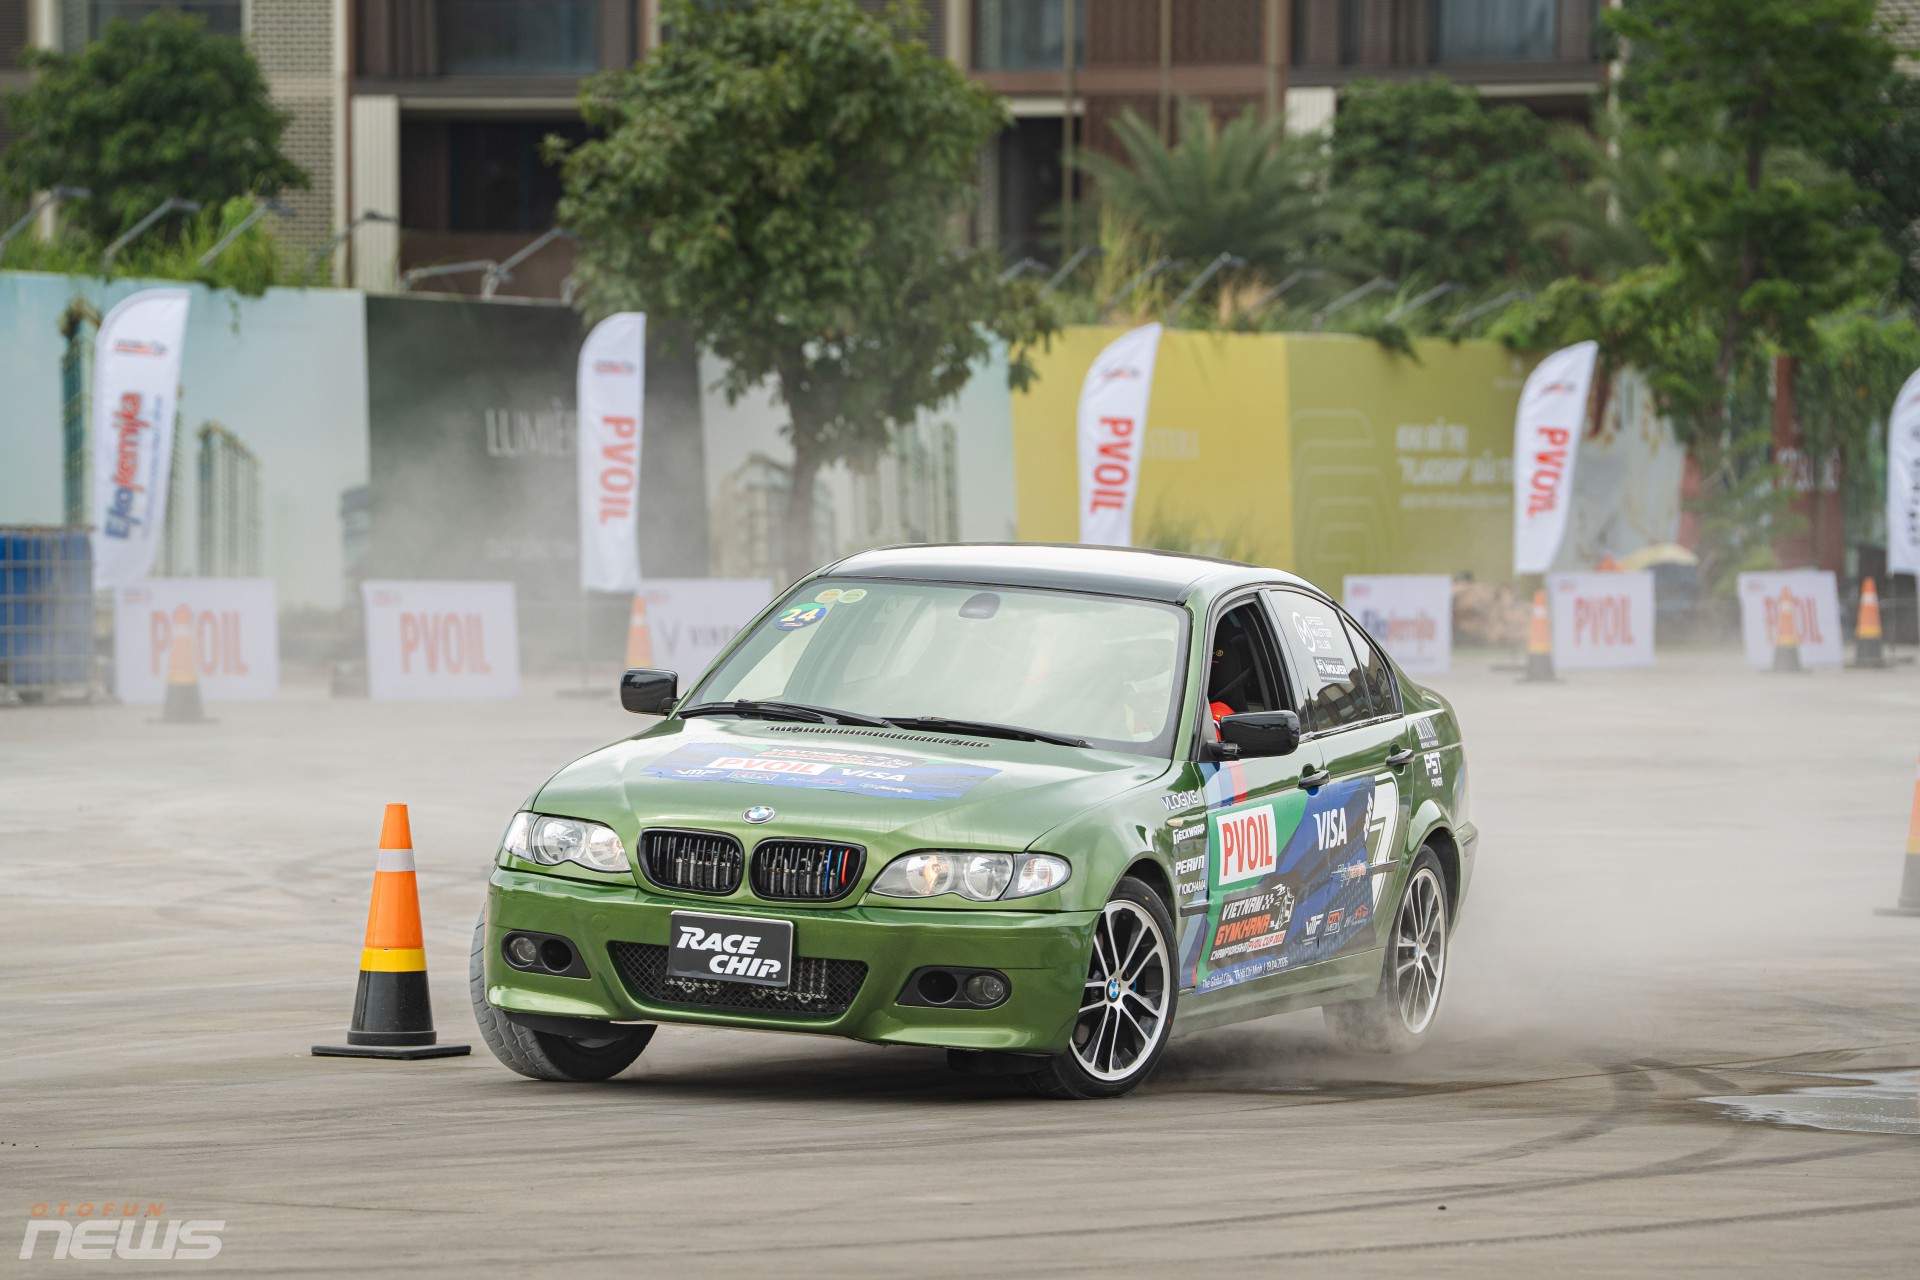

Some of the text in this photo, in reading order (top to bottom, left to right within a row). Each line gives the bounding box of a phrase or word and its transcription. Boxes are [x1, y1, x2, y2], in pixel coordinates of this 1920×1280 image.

[599, 415, 636, 526] PVOIL
[1090, 416, 1135, 514] PVOIL
[1526, 427, 1569, 518] PVOIL
[780, 608, 820, 622] 24
[1573, 595, 1635, 647] PVOIL
[150, 611, 249, 676] POIL
[399, 611, 492, 676] PVOIL
[715, 758, 817, 774] PVOIL
[842, 768, 906, 781] VISA
[1423, 752, 1442, 776] PST
[1222, 814, 1273, 876] PVOIL
[1313, 807, 1347, 850] VISA
[1222, 895, 1264, 920] VIETNAM
[677, 926, 761, 955] RACE
[1215, 914, 1271, 946] GYMKHANA
